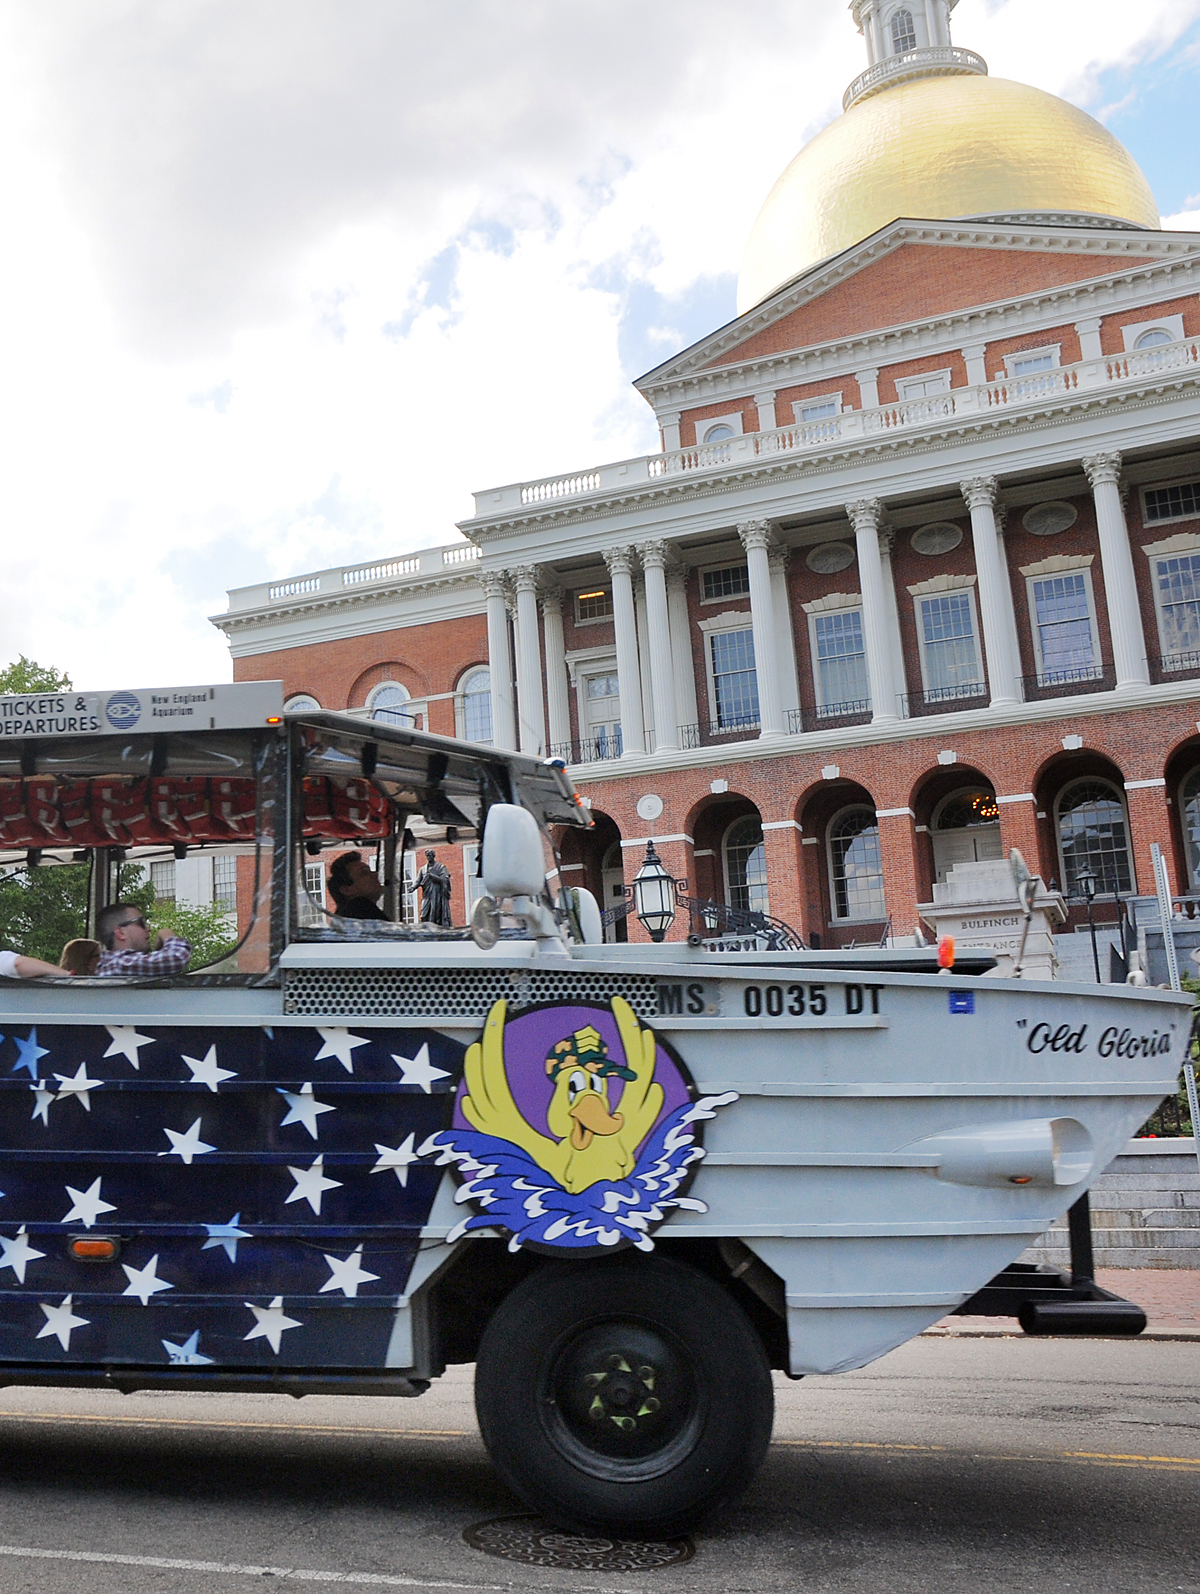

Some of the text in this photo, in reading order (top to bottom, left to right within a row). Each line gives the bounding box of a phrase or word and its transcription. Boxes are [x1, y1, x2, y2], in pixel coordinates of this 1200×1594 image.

[151, 693, 207, 704] New England
[1, 697, 87, 717] TICKETS &
[152, 706, 194, 717] Aquarium
[961, 917, 1019, 929] BULFINCH
[657, 983, 884, 1017] MS 0035 DT
